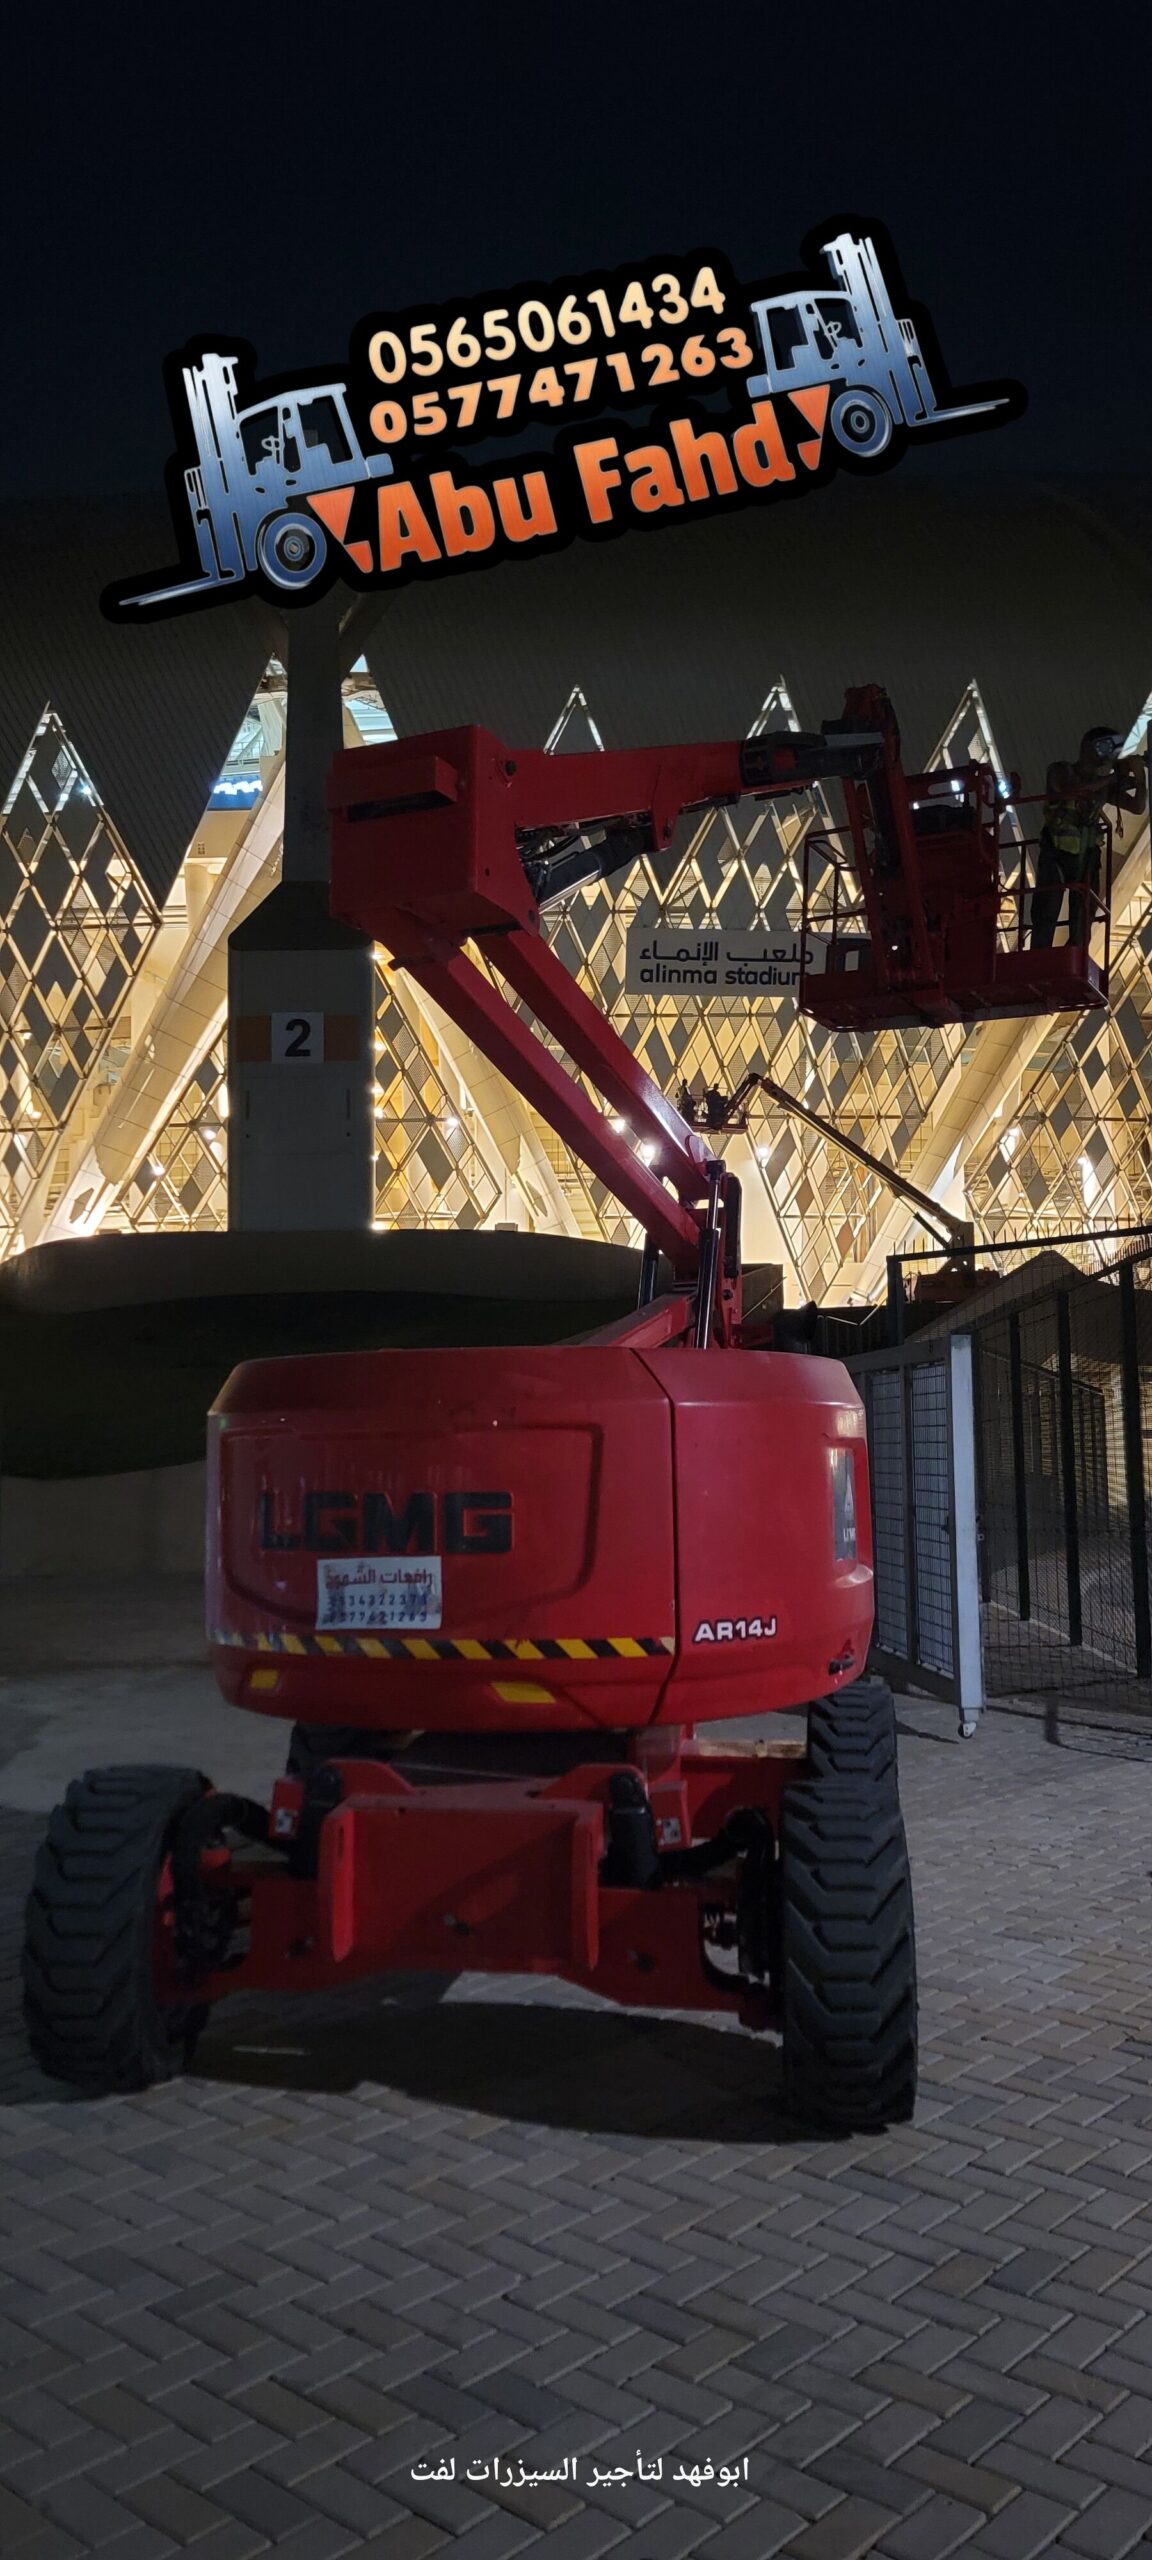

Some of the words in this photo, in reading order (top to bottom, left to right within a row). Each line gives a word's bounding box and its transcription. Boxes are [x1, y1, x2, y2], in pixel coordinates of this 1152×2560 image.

[726, 943, 814, 967] ملعب
[639, 963, 718, 985] alinma
[285, 1018, 311, 1057] 2
[260, 1491, 513, 1554] LGMG
[693, 1616, 777, 1642] AR14J
